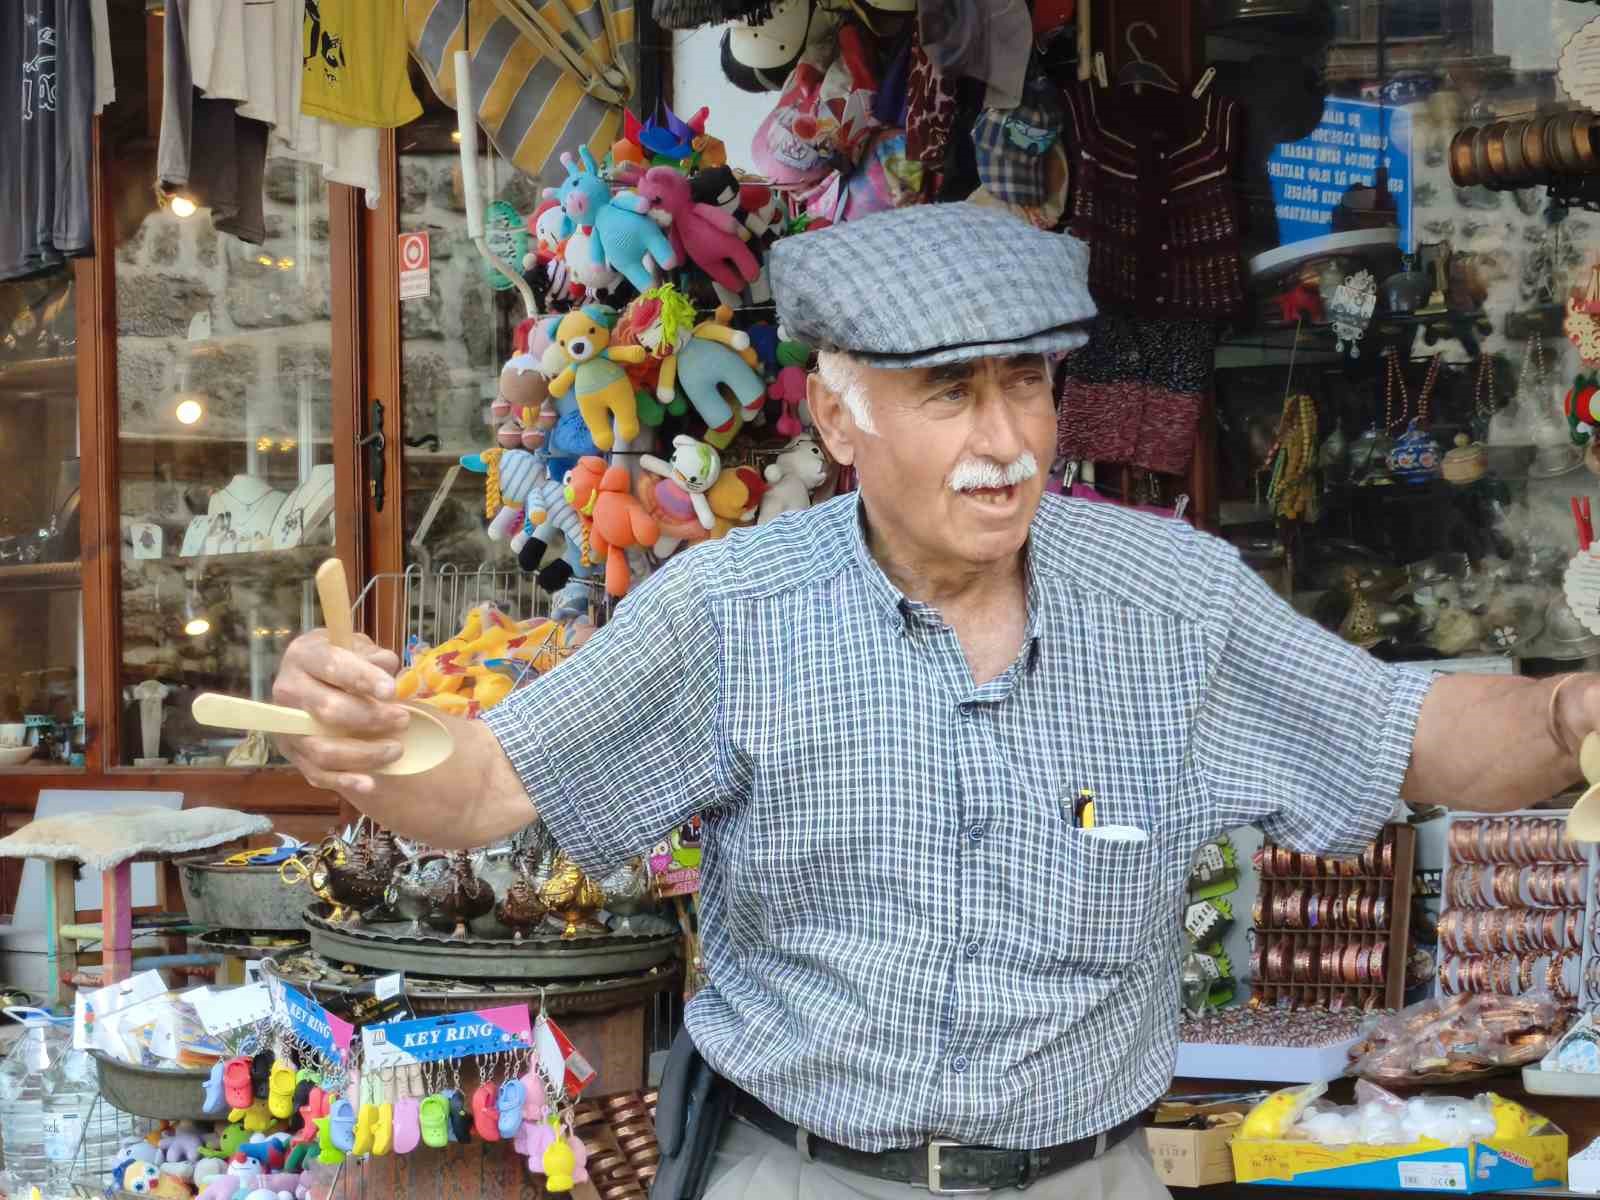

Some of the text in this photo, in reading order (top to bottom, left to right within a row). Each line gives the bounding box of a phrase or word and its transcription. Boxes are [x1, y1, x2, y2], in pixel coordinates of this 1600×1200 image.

[289, 1003, 331, 1038] KEY RING
[403, 1022, 497, 1048] KEY RING
